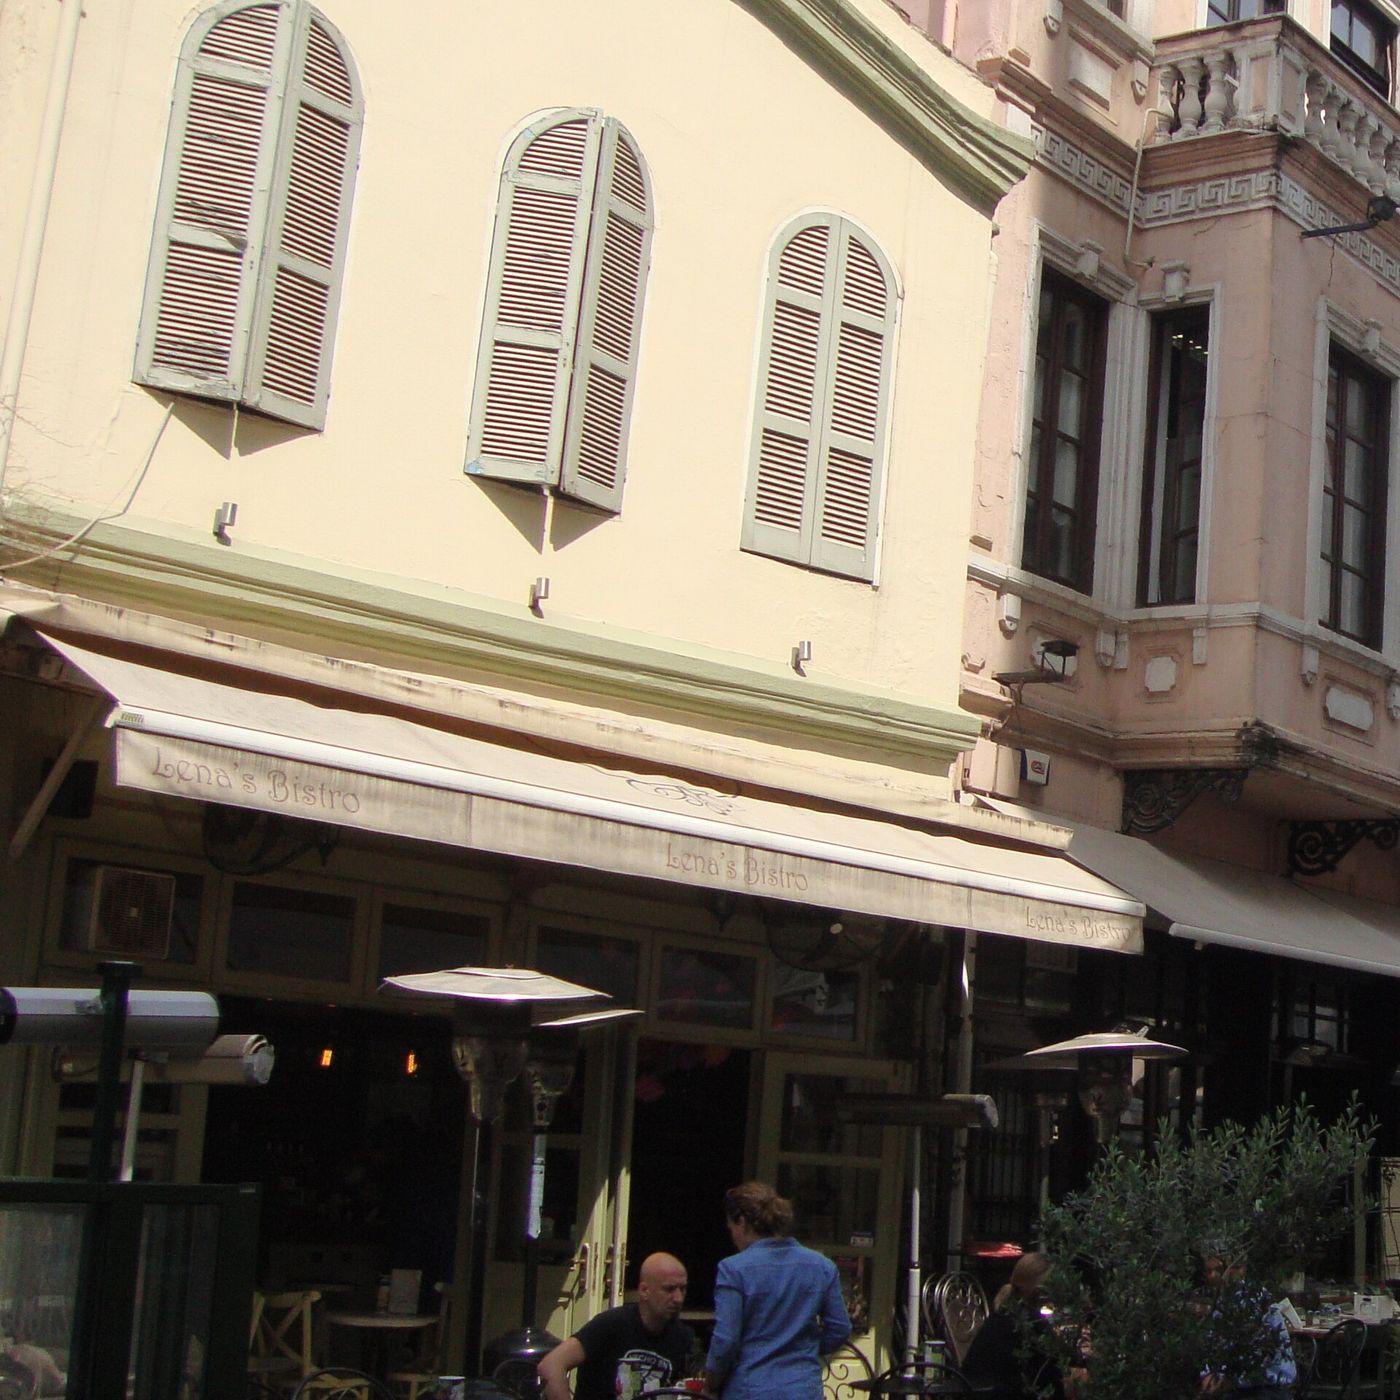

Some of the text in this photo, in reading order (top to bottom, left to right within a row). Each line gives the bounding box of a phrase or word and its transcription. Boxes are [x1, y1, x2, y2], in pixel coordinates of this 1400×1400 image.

[152, 746, 361, 814] Lena's Bistro
[666, 842, 809, 891] Lena's Bistro
[1025, 906, 1078, 936] Lena's
